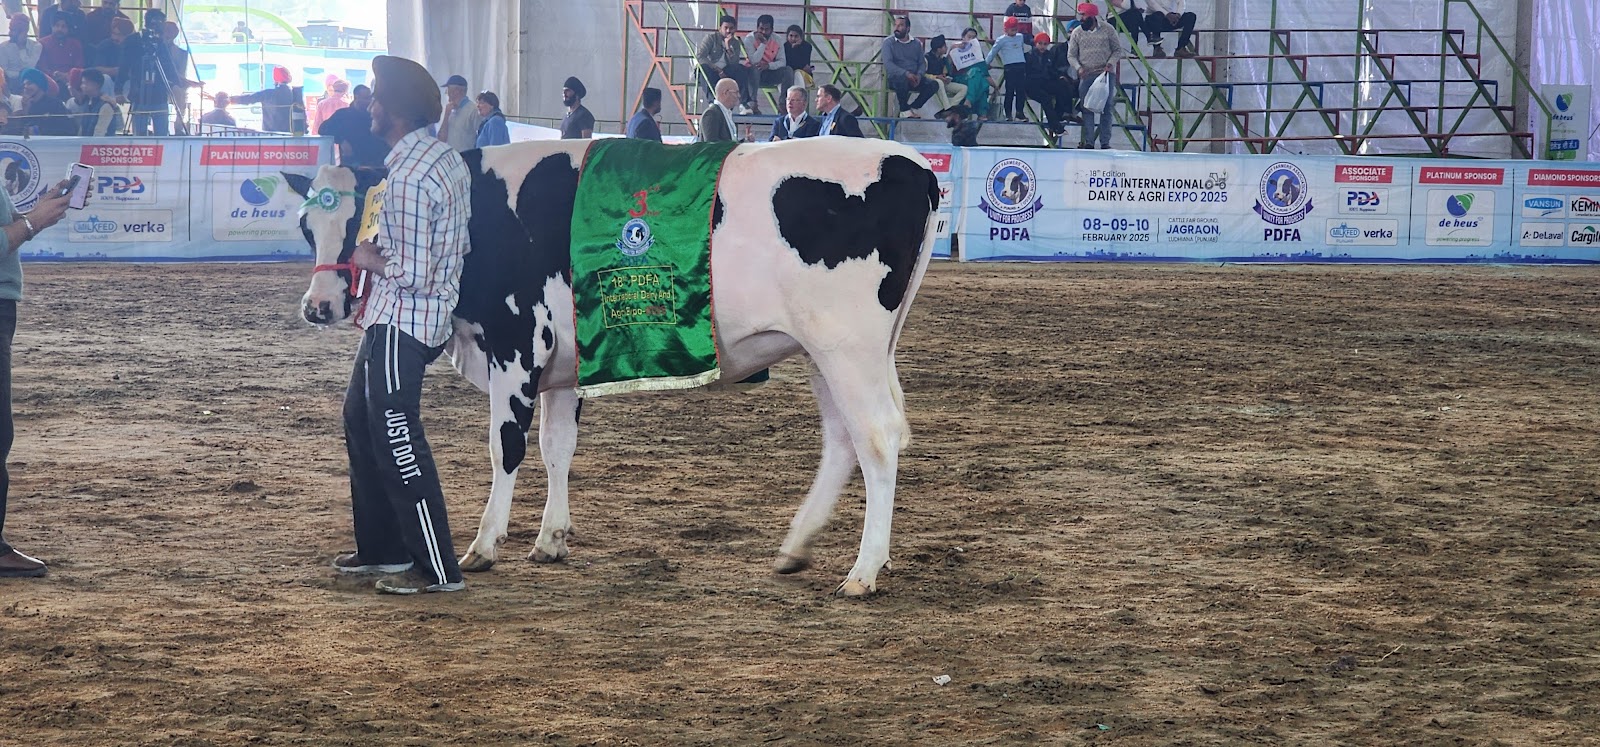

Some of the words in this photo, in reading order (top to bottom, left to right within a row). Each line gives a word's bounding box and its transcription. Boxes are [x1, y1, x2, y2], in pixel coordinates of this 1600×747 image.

[91, 147, 153, 157] ASSOCIATE
[211, 151, 260, 160] PLATINUM
[264, 152, 309, 160] SPONSOR
[1102, 170, 1126, 178] Edition
[1342, 167, 1387, 176] ASSOCIATE
[1426, 172, 1462, 180] PLATINUM
[1464, 172, 1498, 181] SPONSOR
[1533, 173, 1567, 182] DIAMOND
[98, 176, 145, 194] PDS
[1089, 177, 1118, 188] PDFA
[1120, 178, 1204, 190] INTERNATIONAL
[1088, 190, 1125, 202] DAIRY
[1126, 190, 1136, 202] &
[1138, 191, 1165, 202] AGRI
[1168, 191, 1198, 203] EXPO
[1200, 192, 1228, 203] 2025
[1347, 191, 1380, 206] PDS
[1528, 200, 1561, 208] VANSUN
[231, 207, 248, 218] de
[251, 207, 286, 218] heus
[1002, 214, 1011, 224] FOR
[1083, 218, 1150, 231] 08-09-10
[1438, 218, 1451, 228] de
[1453, 218, 1479, 228] heus
[77, 222, 115, 232] MILKFED
[123, 221, 165, 233] verka
[1166, 224, 1222, 236] JAGRAON,
[228, 229, 260, 237] powering
[990, 227, 1030, 241] PDFA
[1082, 233, 1128, 242] FEBRUARY
[1129, 233, 1150, 242] 2025
[1264, 228, 1301, 242] PDFA
[1363, 228, 1393, 239] verka
[1533, 231, 1564, 240] DeLaval
[630, 274, 660, 286] PDFA
[640, 290, 658, 302] Dairy
[658, 289, 671, 299] And
[384, 408, 411, 444] JUST
[391, 443, 416, 467] DO
[399, 463, 423, 485] IT.
